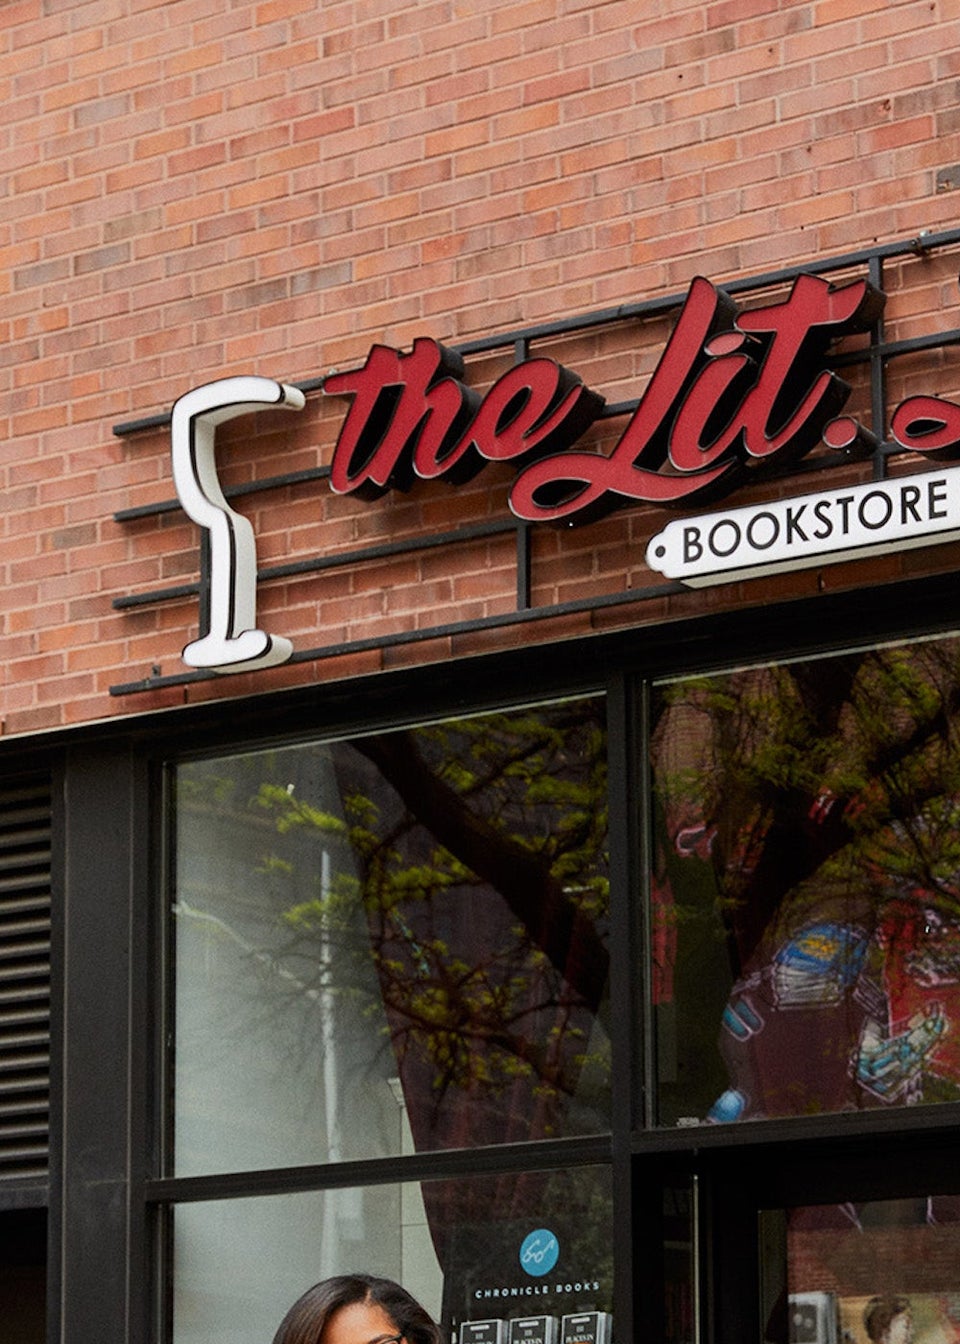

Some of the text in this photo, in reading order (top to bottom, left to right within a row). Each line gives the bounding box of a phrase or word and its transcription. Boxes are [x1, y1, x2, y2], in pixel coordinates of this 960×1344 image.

[322, 336, 594, 497] the
[683, 480, 948, 563] BOOKSTORE
[474, 1281, 600, 1299] CHRONICLE BOOKS
